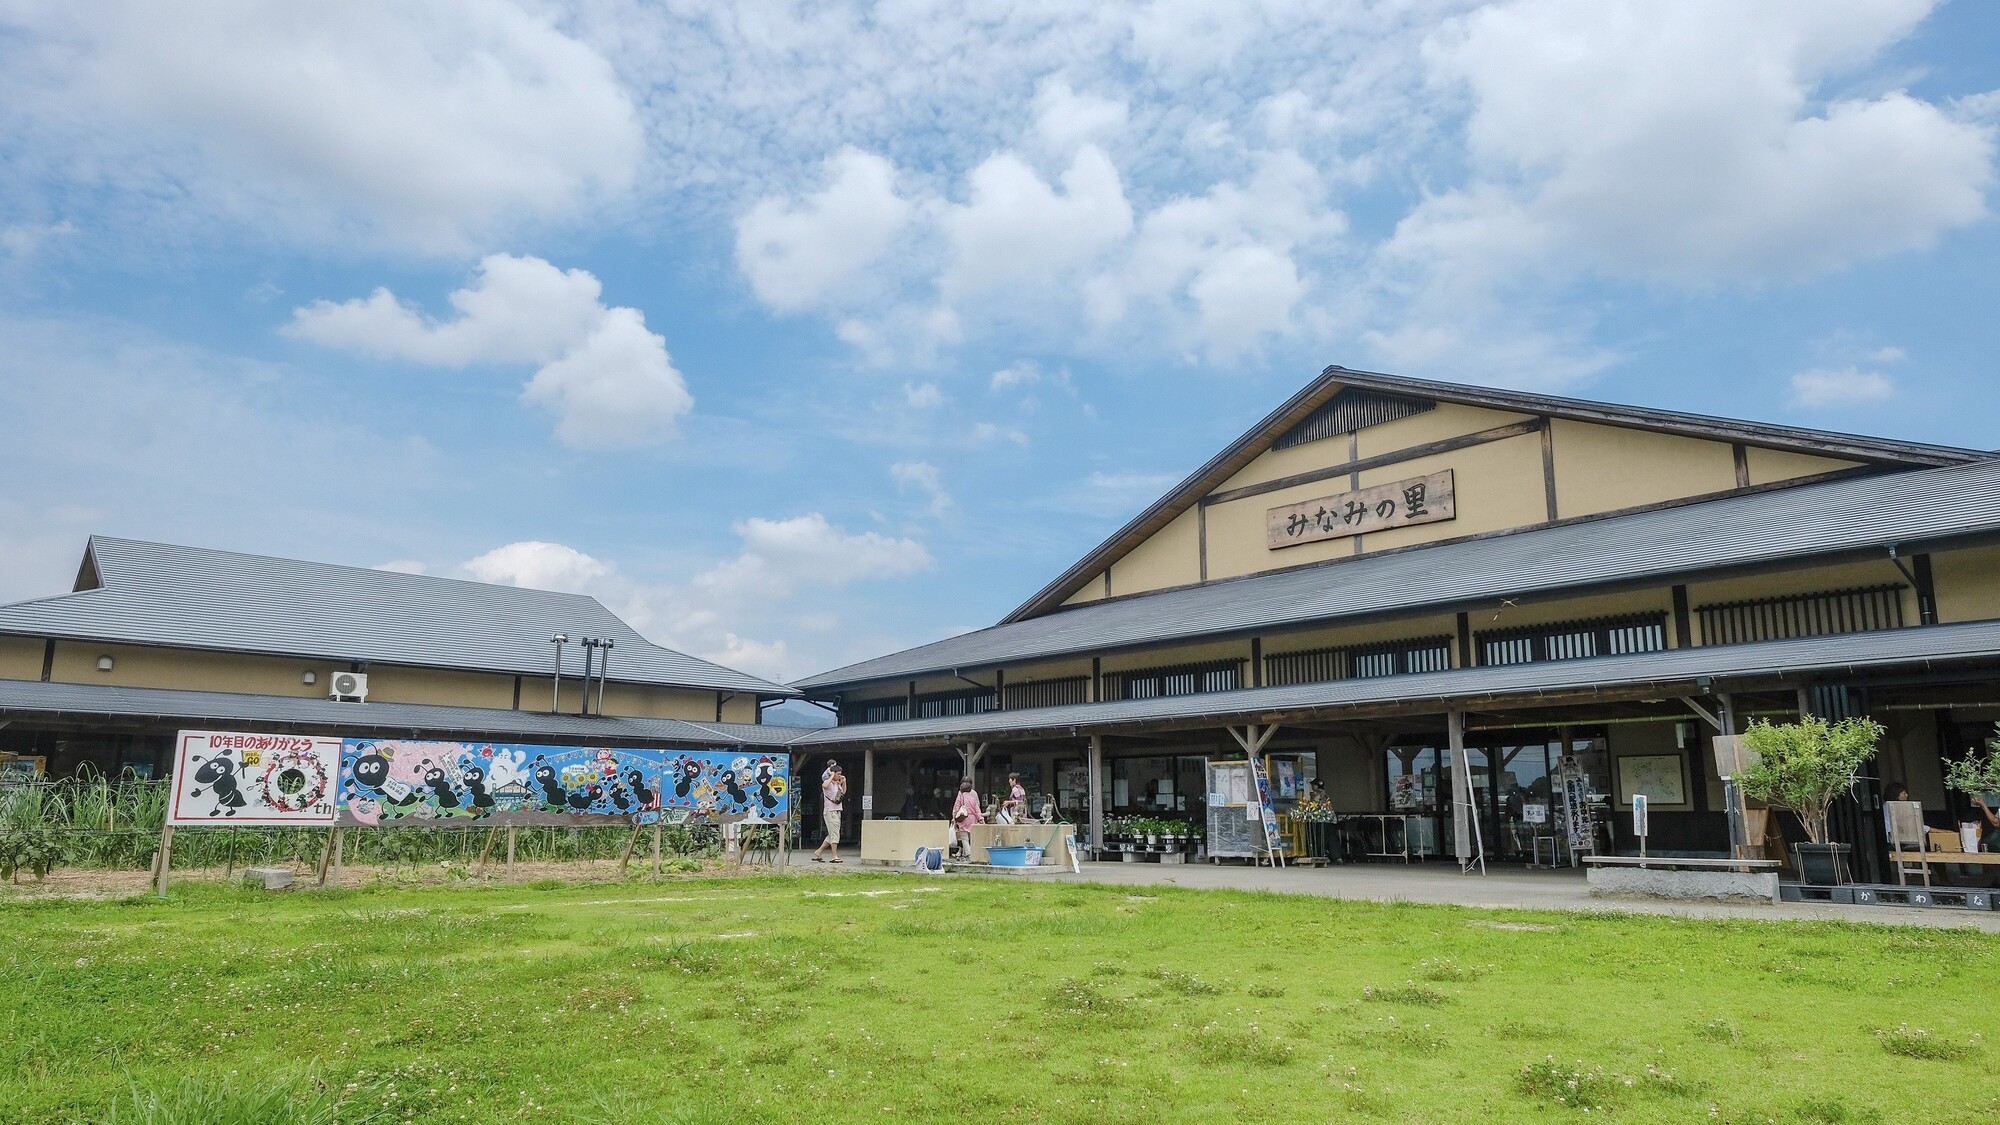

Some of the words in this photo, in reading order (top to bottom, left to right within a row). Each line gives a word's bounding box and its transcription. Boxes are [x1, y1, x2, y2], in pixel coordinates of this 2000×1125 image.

[1286, 483, 1429, 537] みなみの里
[209, 735, 313, 751] 10年目のありがとう
[314, 803, 332, 815] th
